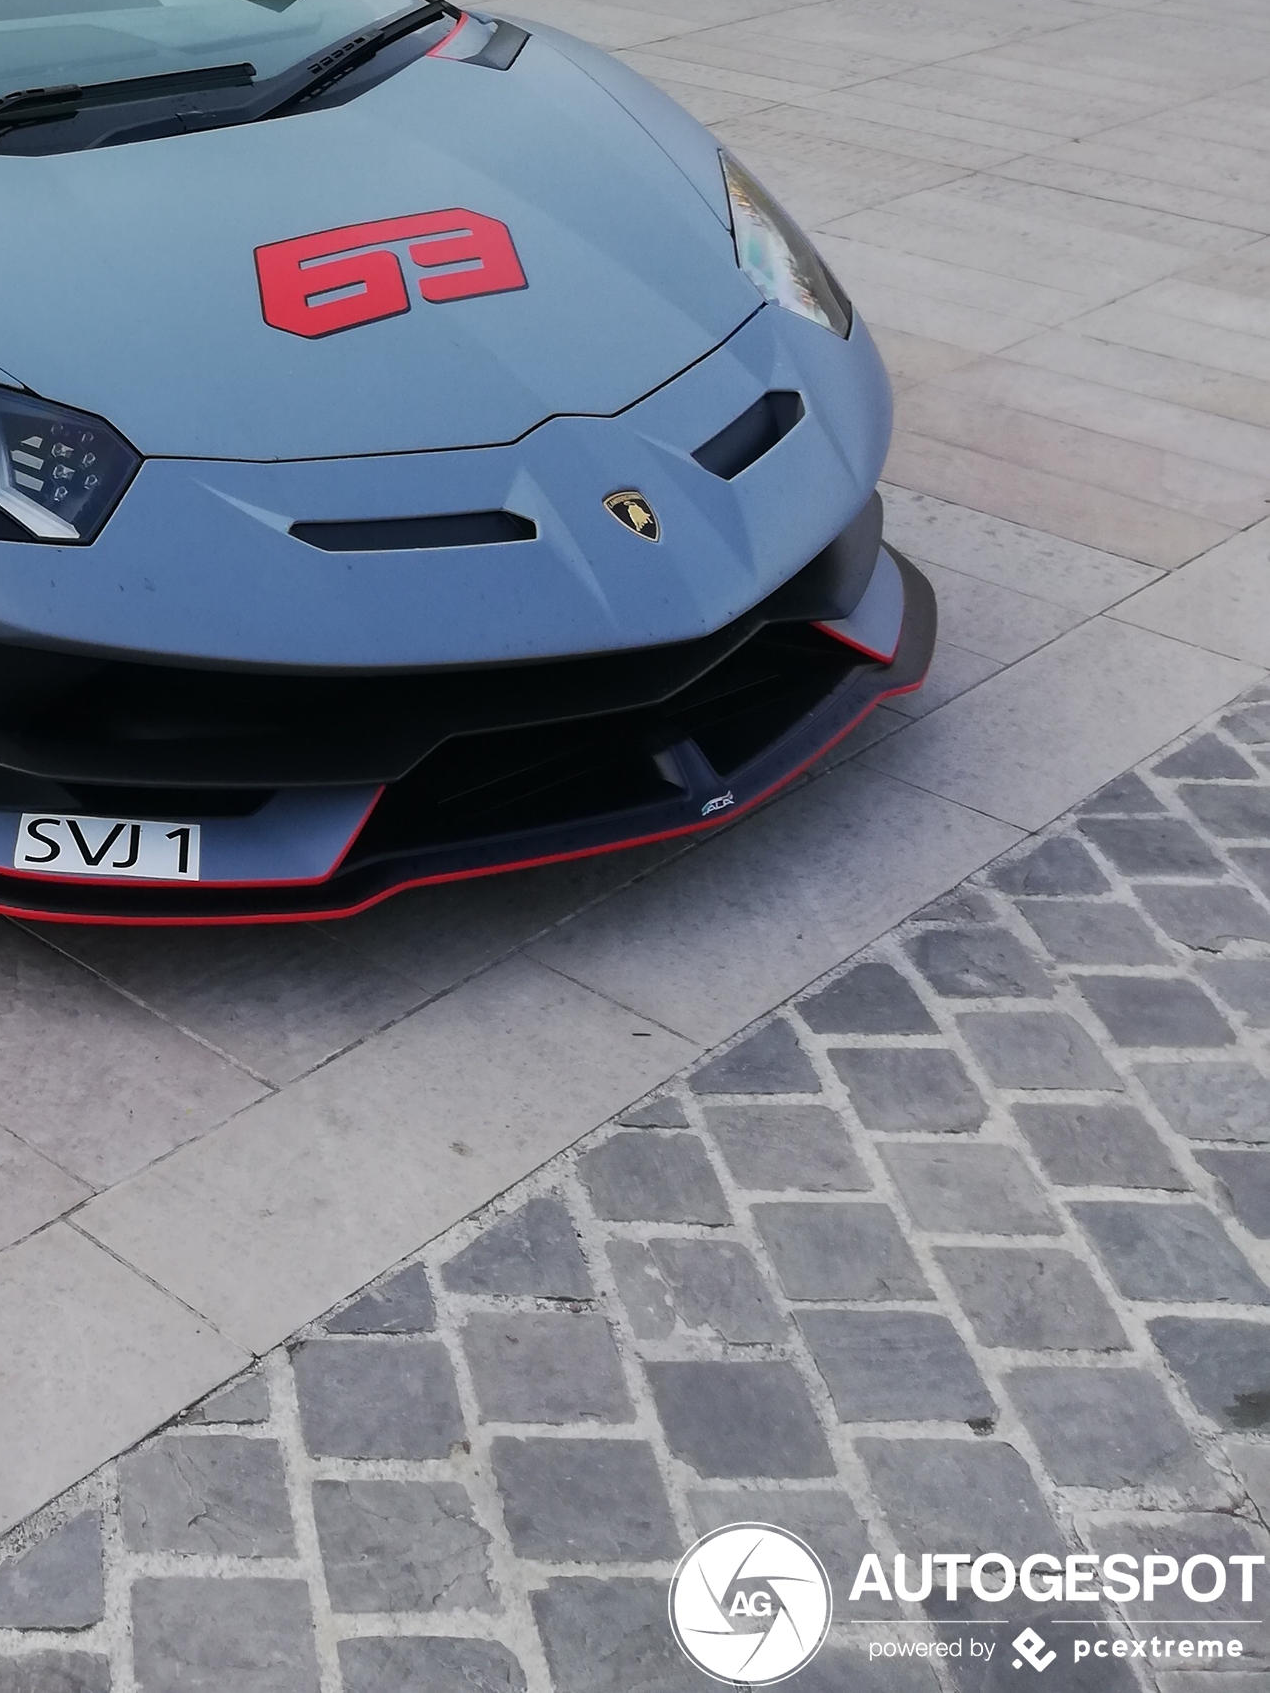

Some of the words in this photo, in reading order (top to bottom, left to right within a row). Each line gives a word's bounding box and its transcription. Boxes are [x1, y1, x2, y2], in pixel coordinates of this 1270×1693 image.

[253, 207, 529, 340] 63
[24, 818, 141, 868] SVJ
[165, 827, 190, 873] 1
